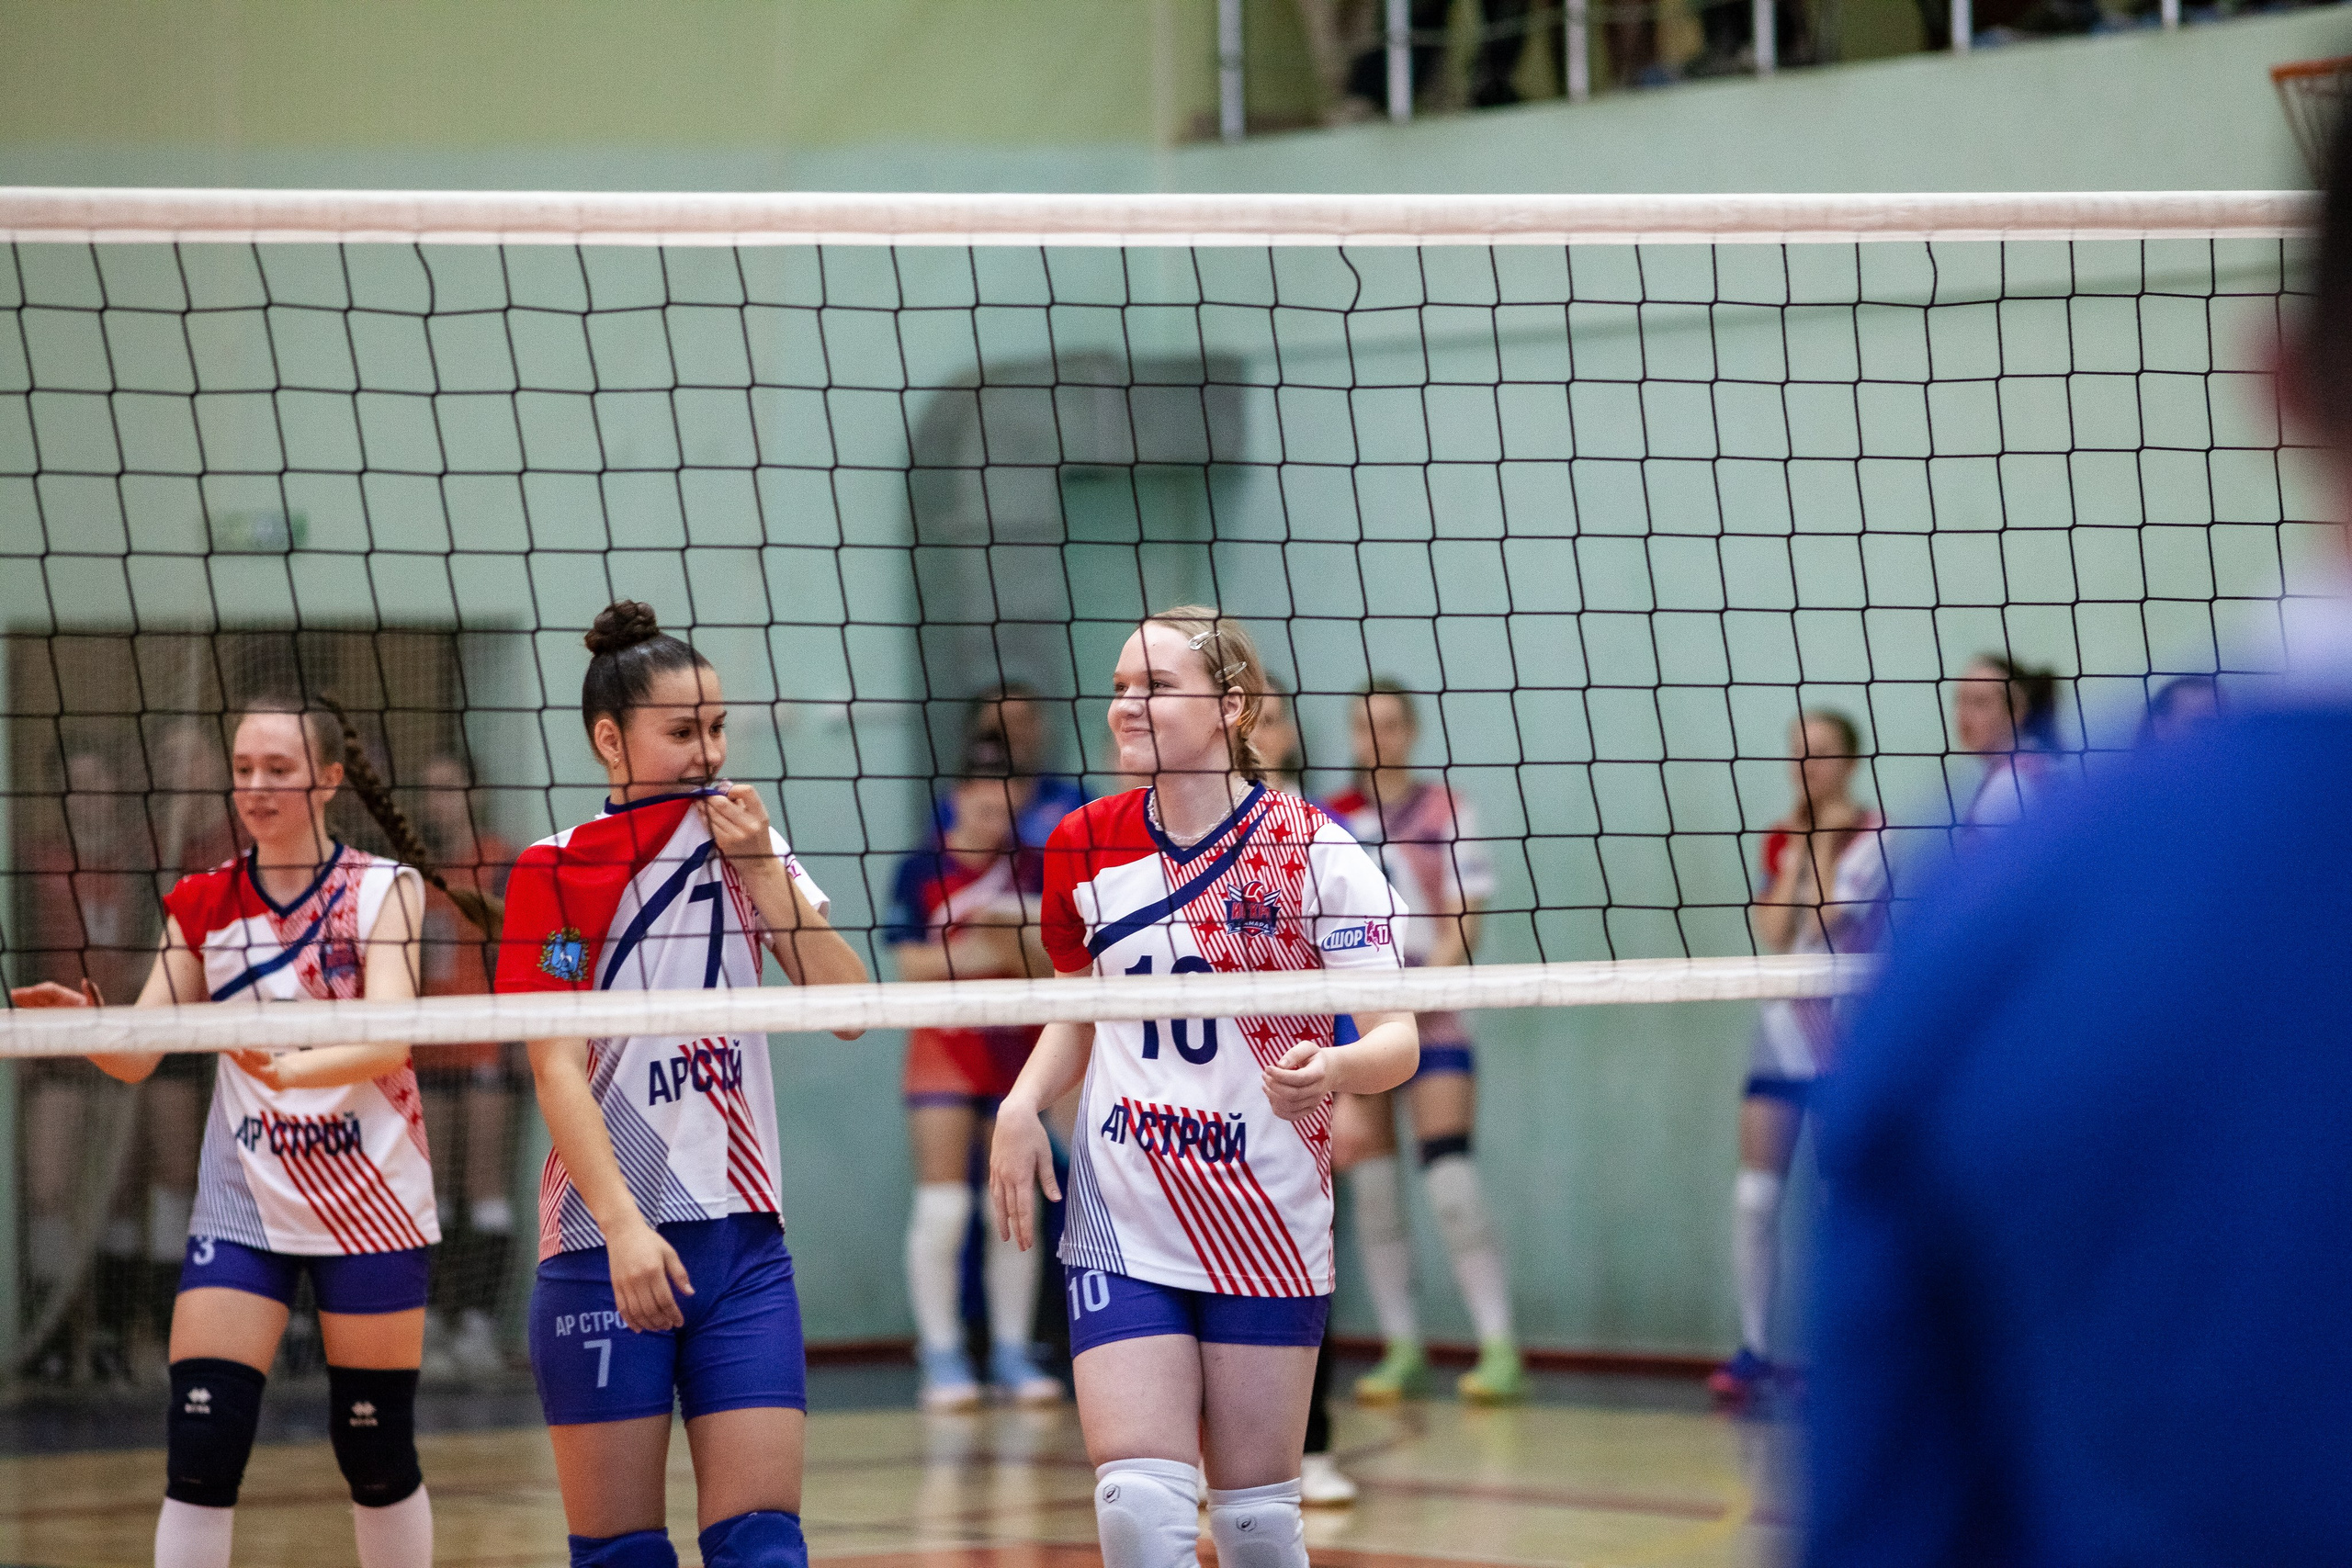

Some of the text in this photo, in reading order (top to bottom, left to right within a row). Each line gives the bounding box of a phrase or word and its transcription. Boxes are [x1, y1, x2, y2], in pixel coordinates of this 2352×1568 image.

[688, 881, 724, 988] 7
[1323, 925, 1388, 950] СШОР 17
[1125, 955, 1218, 1065] 10
[649, 1056, 689, 1106] АР
[236, 1111, 362, 1158] АР СТРОЙ
[1135, 1111, 1246, 1164] СТРОЙ
[193, 1235, 215, 1265] 3
[1069, 1269, 1110, 1320] 10
[556, 1311, 628, 1337] АР СТРО
[583, 1338, 612, 1388] 7
